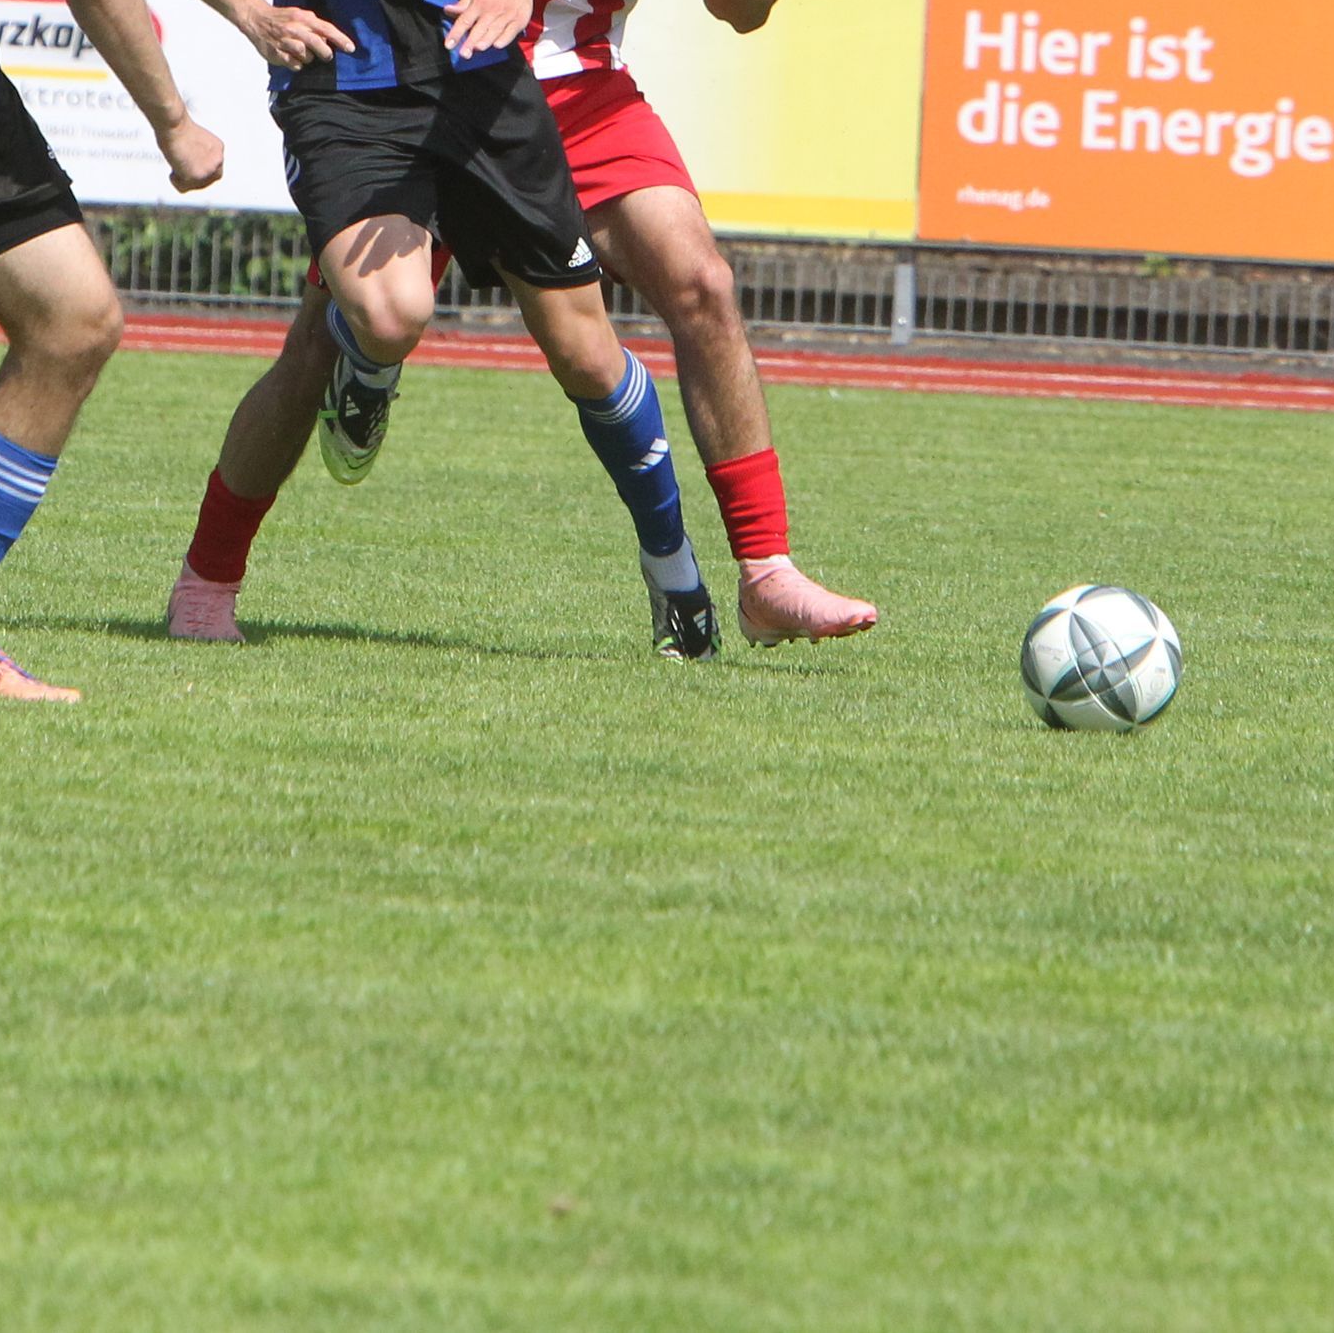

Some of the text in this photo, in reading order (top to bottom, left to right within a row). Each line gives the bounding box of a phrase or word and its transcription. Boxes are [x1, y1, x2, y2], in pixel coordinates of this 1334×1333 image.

[963, 10, 1214, 83] Hier ist
[957, 81, 1060, 148] die
